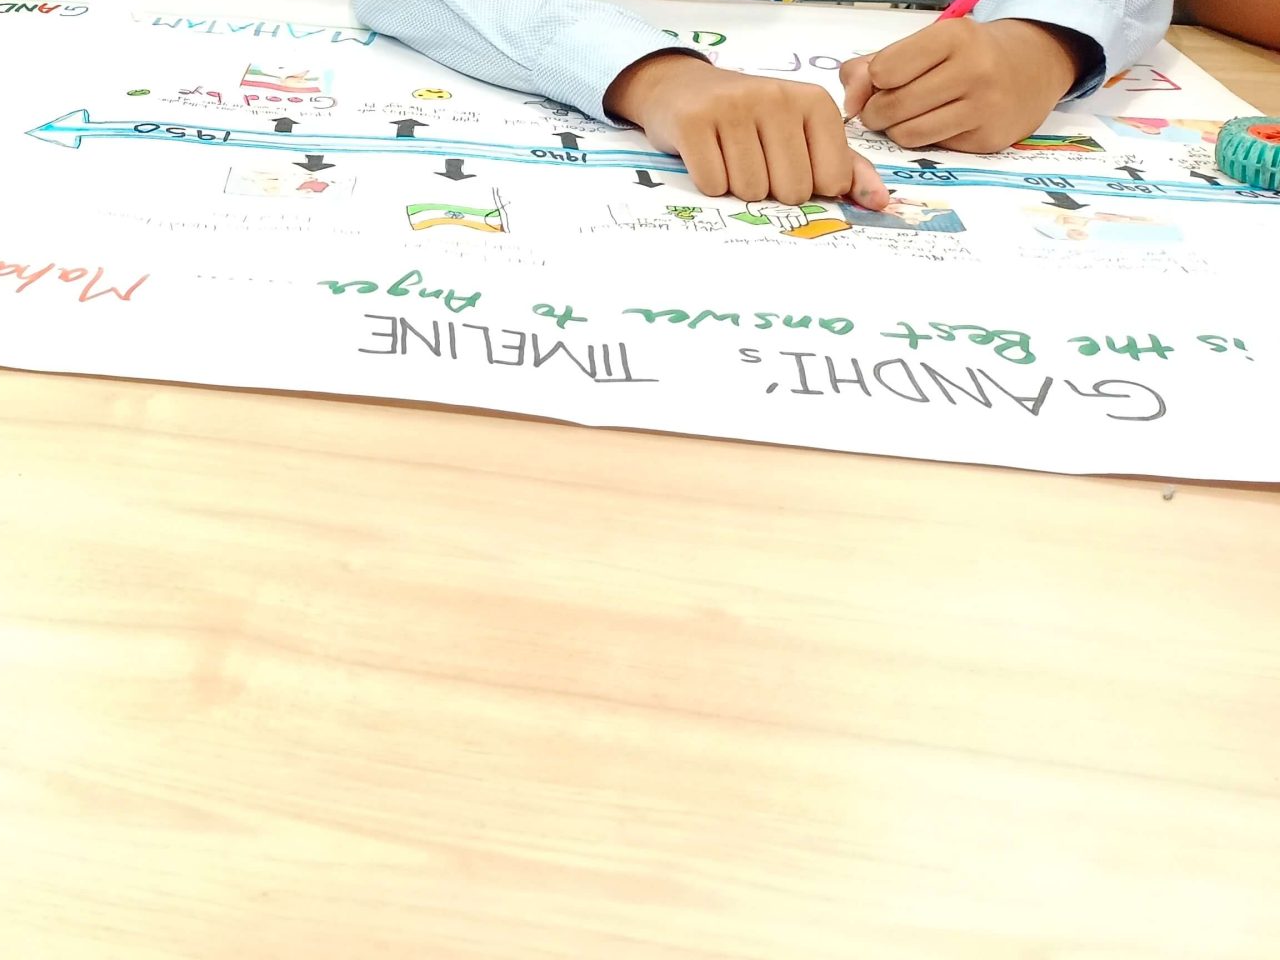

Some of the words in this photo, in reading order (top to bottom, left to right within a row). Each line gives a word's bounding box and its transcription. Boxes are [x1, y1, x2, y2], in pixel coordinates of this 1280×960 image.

[178, 85, 222, 106] bye
[243, 93, 337, 110] Good
[133, 123, 232, 144] 1950
[530, 149, 587, 164] 1940
[892, 170, 959, 183] 1920
[1022, 175, 1071, 189] 1910
[1106, 182, 1168, 194] 1890
[316, 268, 482, 315] Anger
[530, 302, 588, 331] to
[621, 307, 854, 337] answer
[357, 313, 659, 384] TIMELINE
[879, 321, 1037, 365] Best
[1066, 333, 1175, 362] the
[1195, 332, 1255, 363] is
